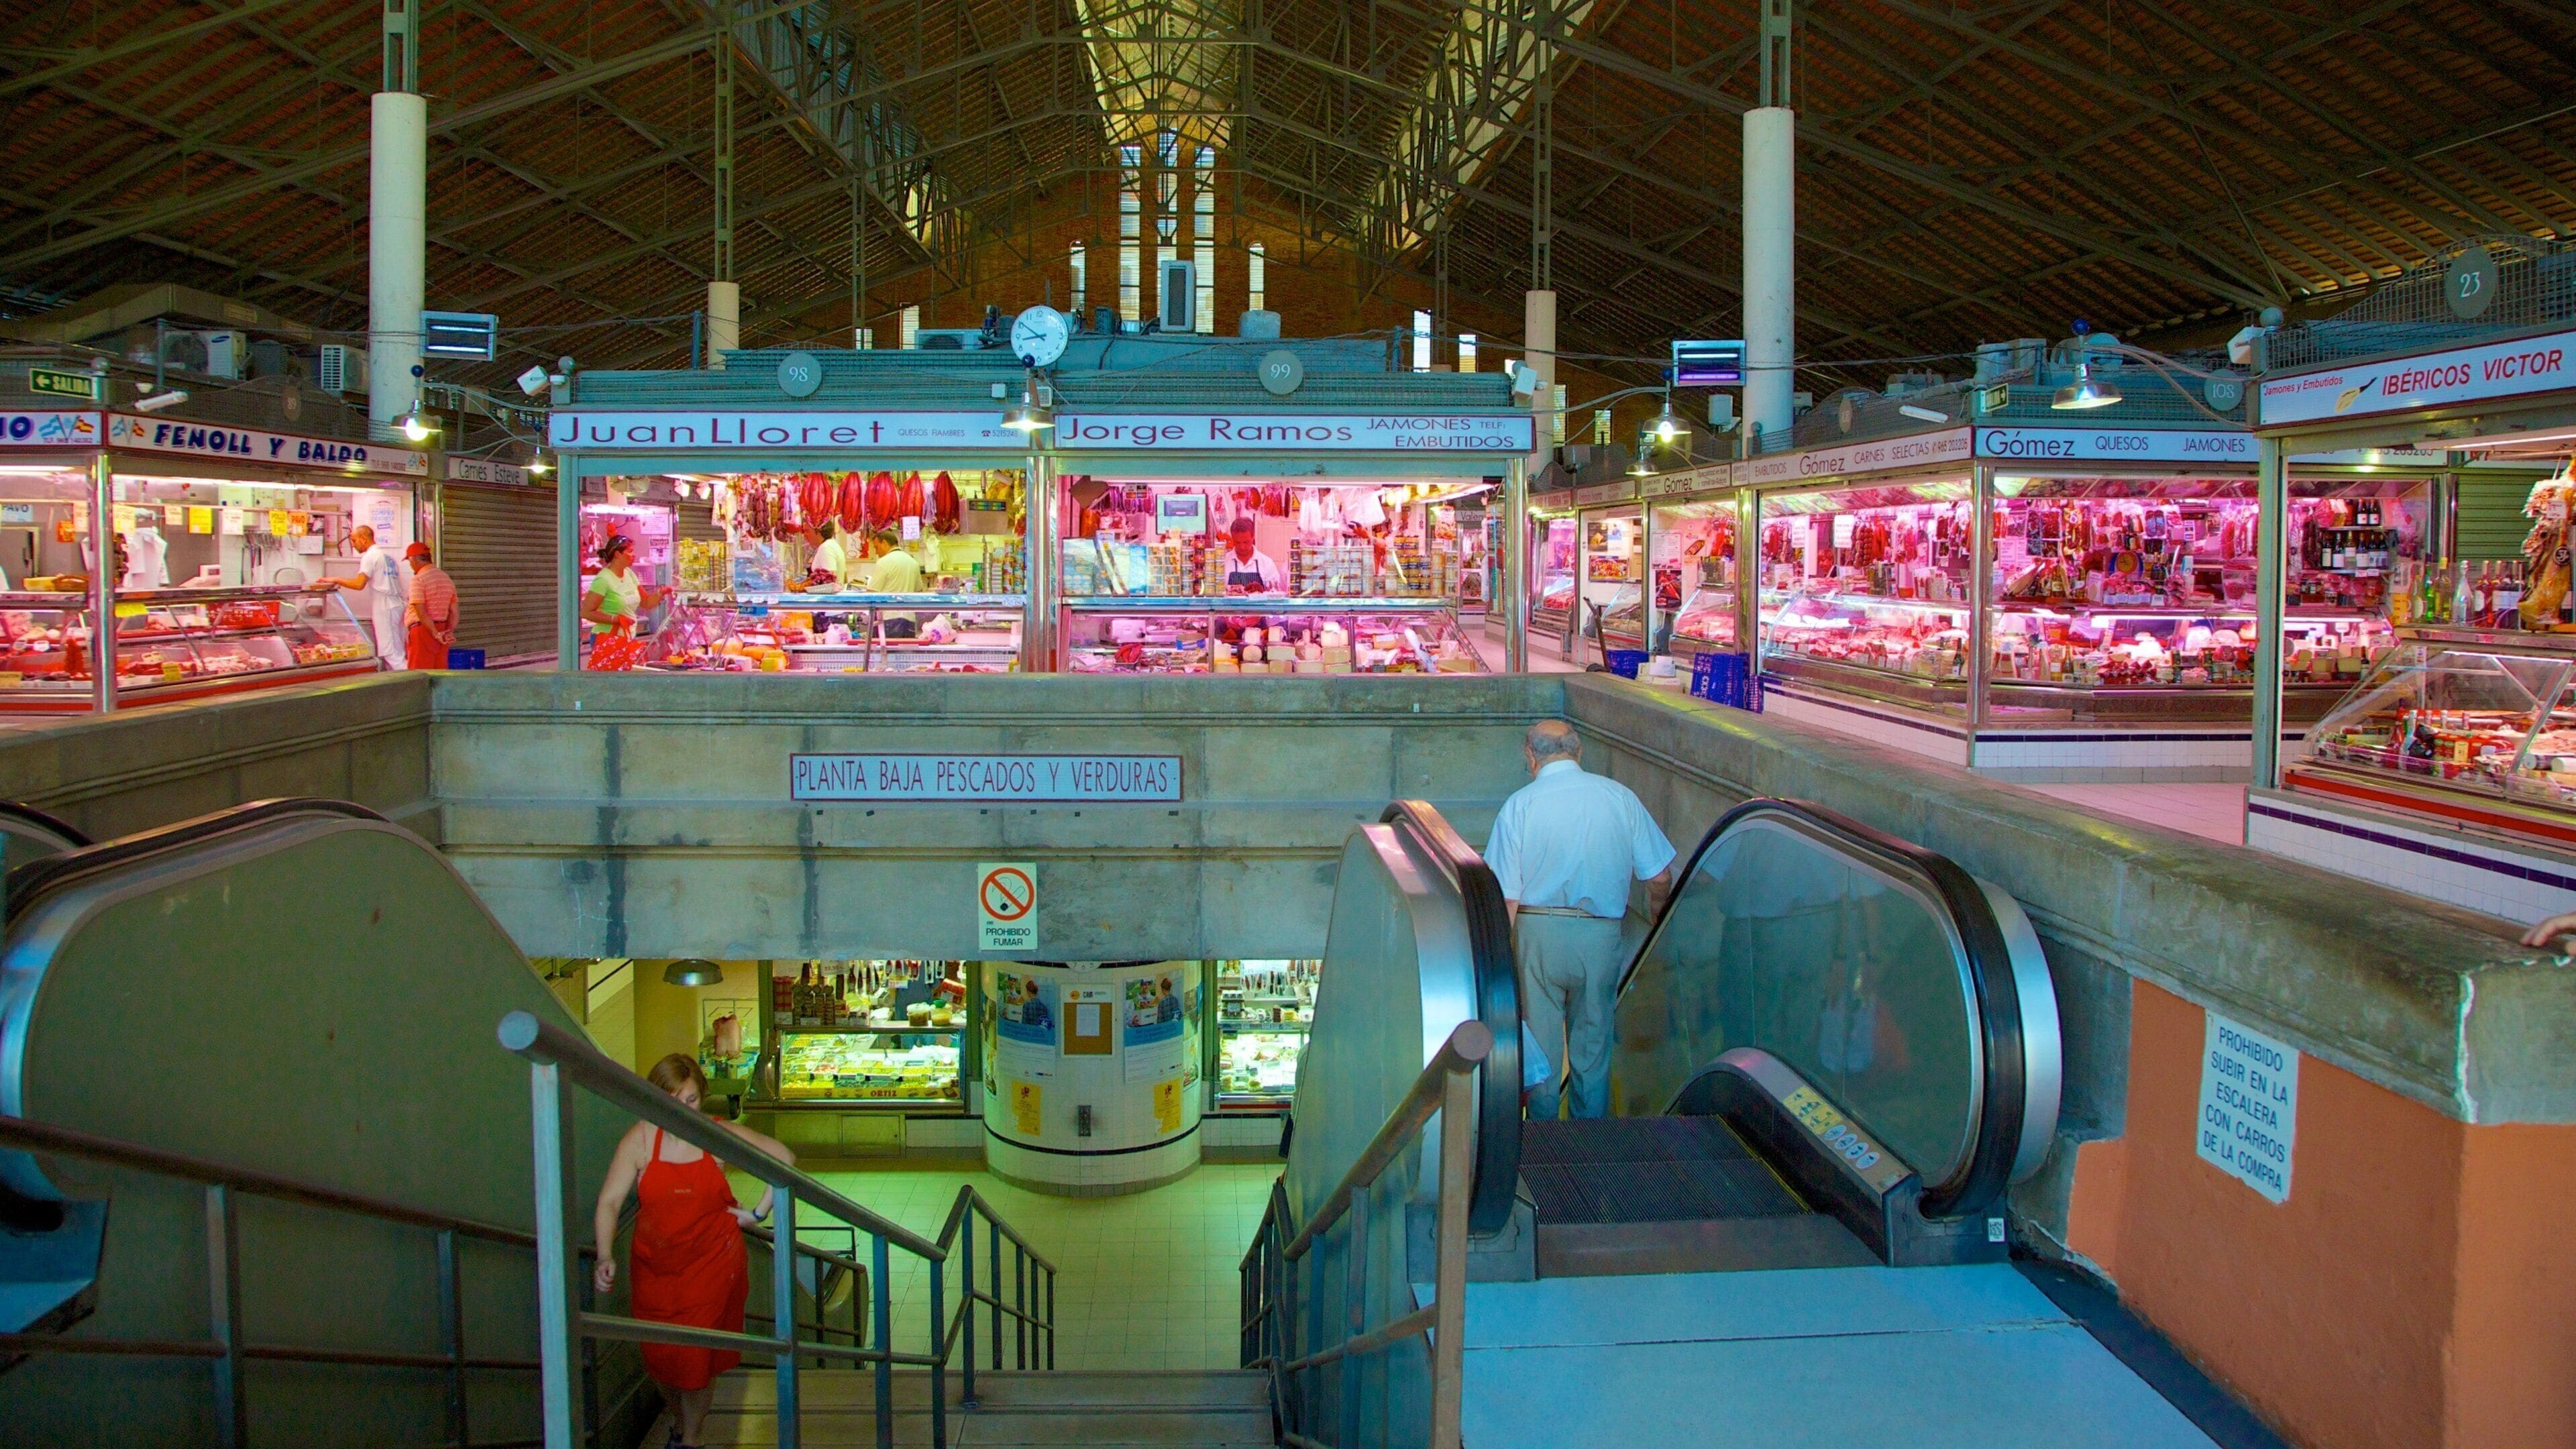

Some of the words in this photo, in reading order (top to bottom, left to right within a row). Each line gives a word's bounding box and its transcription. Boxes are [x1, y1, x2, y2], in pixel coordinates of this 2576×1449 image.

[2460, 271, 2481, 298] 23
[1026, 313, 1032, 321] 11
[789, 366, 808, 382] 98
[1271, 364, 1291, 380] 99
[2382, 363, 2471, 396] IBÉRICOS
[2483, 349, 2563, 381] VICTOR
[52, 376, 90, 394] SALIDA
[2212, 384, 2235, 399] 108
[2263, 383, 2295, 396] Jamones
[2296, 384, 2302, 393] y
[2303, 376, 2343, 390] Embutidos
[559, 417, 694, 443] Juan
[711, 418, 885, 444] Lloret
[898, 429, 928, 437] QUESOS
[1061, 418, 1185, 445] Jorge
[1210, 418, 1352, 441] Ramos
[1366, 418, 1471, 431] JAMONES
[1479, 421, 1506, 429] TELF:
[153, 423, 252, 455] FENOLL
[269, 437, 286, 458] Y
[297, 440, 368, 463] BALDO
[1395, 435, 1514, 448] EMBUTIDOS
[1985, 430, 2075, 456] Gómez
[2095, 435, 2149, 451] QUESOS
[2184, 437, 2245, 452] JAMONES
[1755, 462, 1787, 476] EMBUTIDOS
[1800, 453, 1845, 475] Gómez
[1854, 448, 1884, 464] CARNES
[1892, 441, 1930, 460] SELECTAS
[1937, 440, 1947, 453] 965
[459, 460, 488, 481] Carnes
[494, 464, 520, 484] Esteve
[1664, 476, 1693, 493] Gómez
[798, 761, 867, 790] PLANTA
[879, 761, 924, 791] BAJA
[936, 761, 1035, 792] PESCADOS
[1049, 762, 1059, 792] Y
[1071, 762, 1168, 793] VERDURAS
[985, 928, 1031, 936] PROHIBIDO
[993, 938, 1024, 946] FUMAR
[2218, 1026, 2284, 1072] PROHIBIDO
[2210, 1051, 2245, 1083] SUBIR
[2250, 1069, 2267, 1094] EN
[2272, 1081, 2288, 1106] LA
[870, 1089, 898, 1097] ORTIZ
[2216, 1081, 2278, 1130] ESCALERA
[2205, 1104, 2231, 1132] CON
[2235, 1121, 2285, 1163] CARROS
[2204, 1130, 2217, 1153] DE
[2220, 1140, 2234, 1164] LA
[2237, 1150, 2282, 1192] COMPRA
